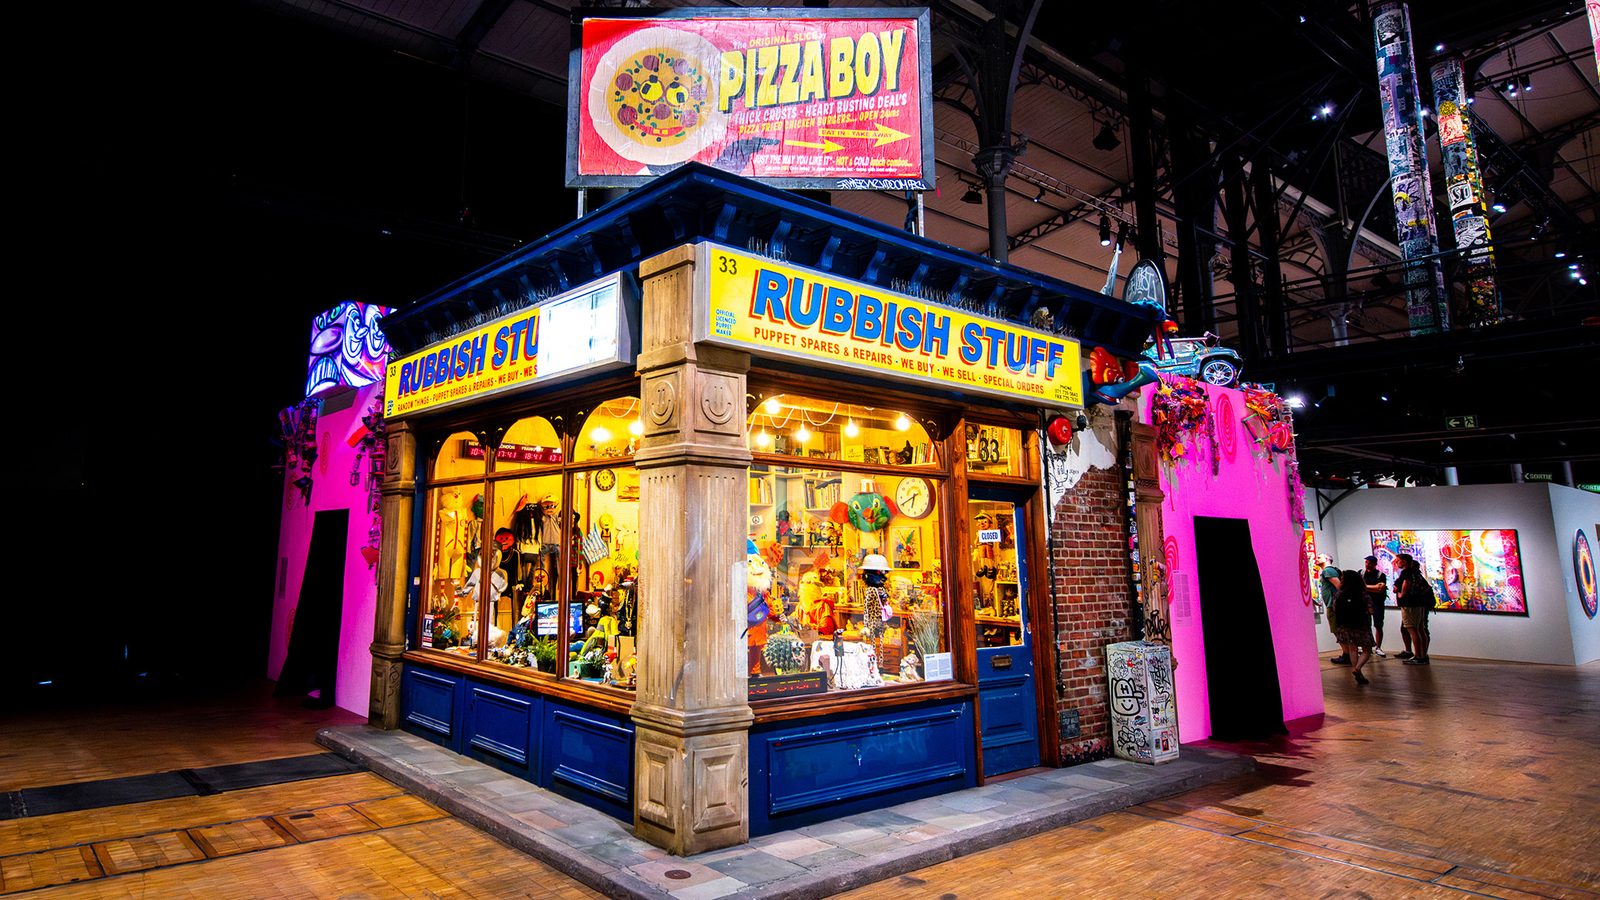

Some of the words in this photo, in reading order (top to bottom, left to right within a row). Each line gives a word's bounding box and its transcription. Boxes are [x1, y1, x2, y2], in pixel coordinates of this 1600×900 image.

[749, 35, 791, 47] ORIGINAL
[794, 31, 818, 41] SLICE
[719, 40, 827, 112] PIZZA
[829, 28, 907, 98] BOY
[735, 110, 761, 125] THICK
[764, 106, 797, 121] CRUSTS
[806, 102, 834, 117] HEART
[837, 97, 875, 113] BUSTING
[877, 93, 907, 108] DEAL'S
[739, 124, 759, 134] PIZZA
[761, 121, 782, 131] FRIED
[785, 118, 815, 129] CHICKEN
[859, 110, 879, 121] OPEN
[770, 154, 782, 164] THE
[782, 154, 796, 165] WAY
[796, 154, 809, 165] YOU
[809, 155, 823, 166] LIKE
[836, 156, 848, 166] HOT
[854, 156, 870, 166] COLD
[718, 255, 738, 276] 33
[748, 268, 951, 360] RUBBISH
[958, 322, 1065, 381] STUFF
[390, 365, 396, 377] 33
[398, 332, 488, 400] RUBBISH
[753, 327, 797, 347] PUPPET
[800, 337, 840, 355] SPARES
[843, 346, 850, 357] &
[853, 347, 893, 366] REPAIRS
[900, 357, 914, 370] WE
[917, 361, 934, 374] BUY
[942, 366, 955, 378] WE
[957, 369, 976, 382] SELL
[983, 375, 1014, 389] SPECIAL
[1016, 381, 1045, 395] ORDERS
[398, 401, 413, 411] RANDOM
[415, 396, 429, 407] THINGS
[433, 390, 449, 402] PUPPET
[450, 385, 467, 397] SPARES
[468, 384, 472, 393] &
[473, 377, 494, 392] REPAIRS
[498, 374, 506, 384] WE
[508, 370, 519, 382] BUY
[523, 365, 533, 378] WE
[979, 438, 999, 464] 33
[981, 531, 999, 540] CLOSED
[1120, 684, 1129, 695] H
